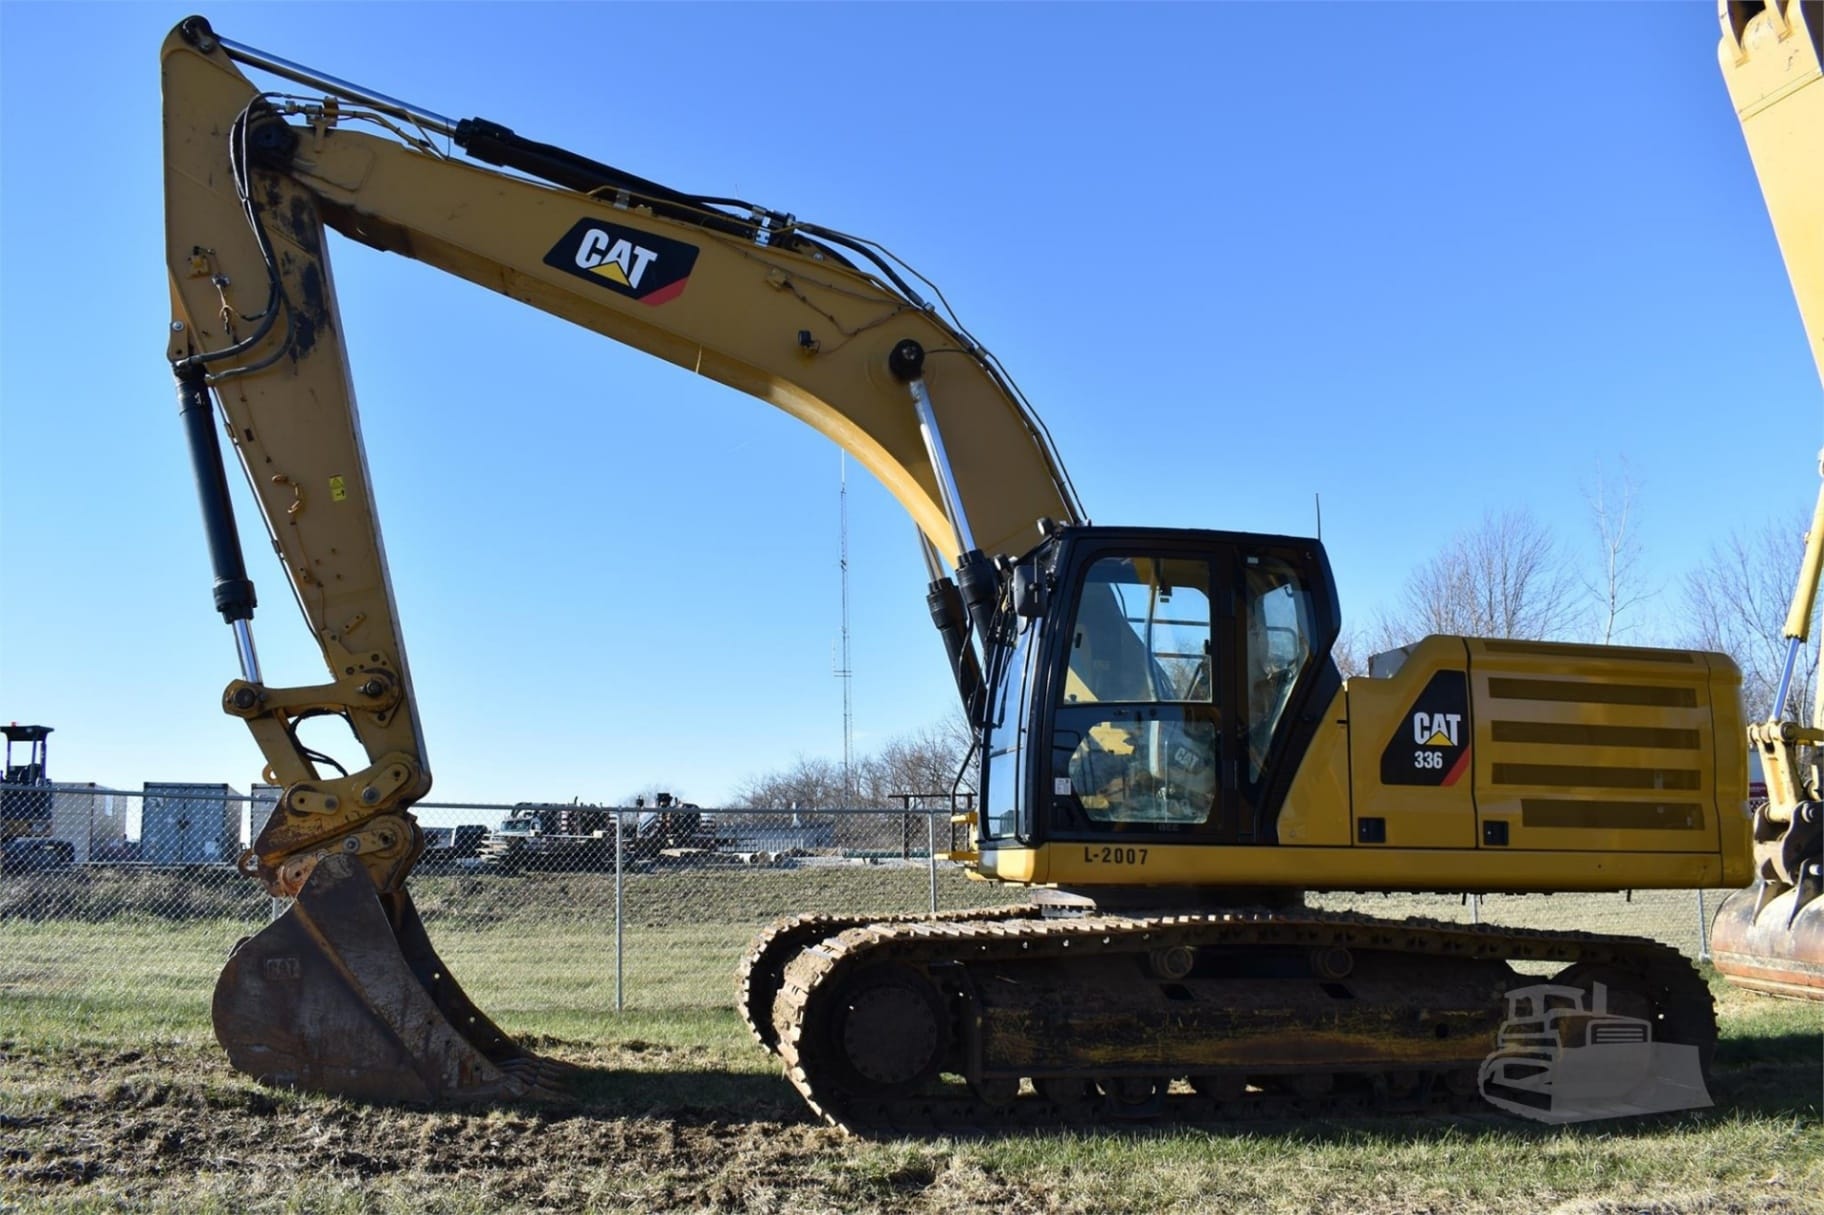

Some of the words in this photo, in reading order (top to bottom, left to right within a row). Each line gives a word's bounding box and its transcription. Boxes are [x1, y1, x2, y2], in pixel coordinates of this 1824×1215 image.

[575, 228, 658, 289] CAT
[1413, 711, 1461, 746] CAT
[1174, 746, 1200, 768] CAT
[1414, 751, 1443, 769] 336
[1084, 846, 1148, 865] L-2007
